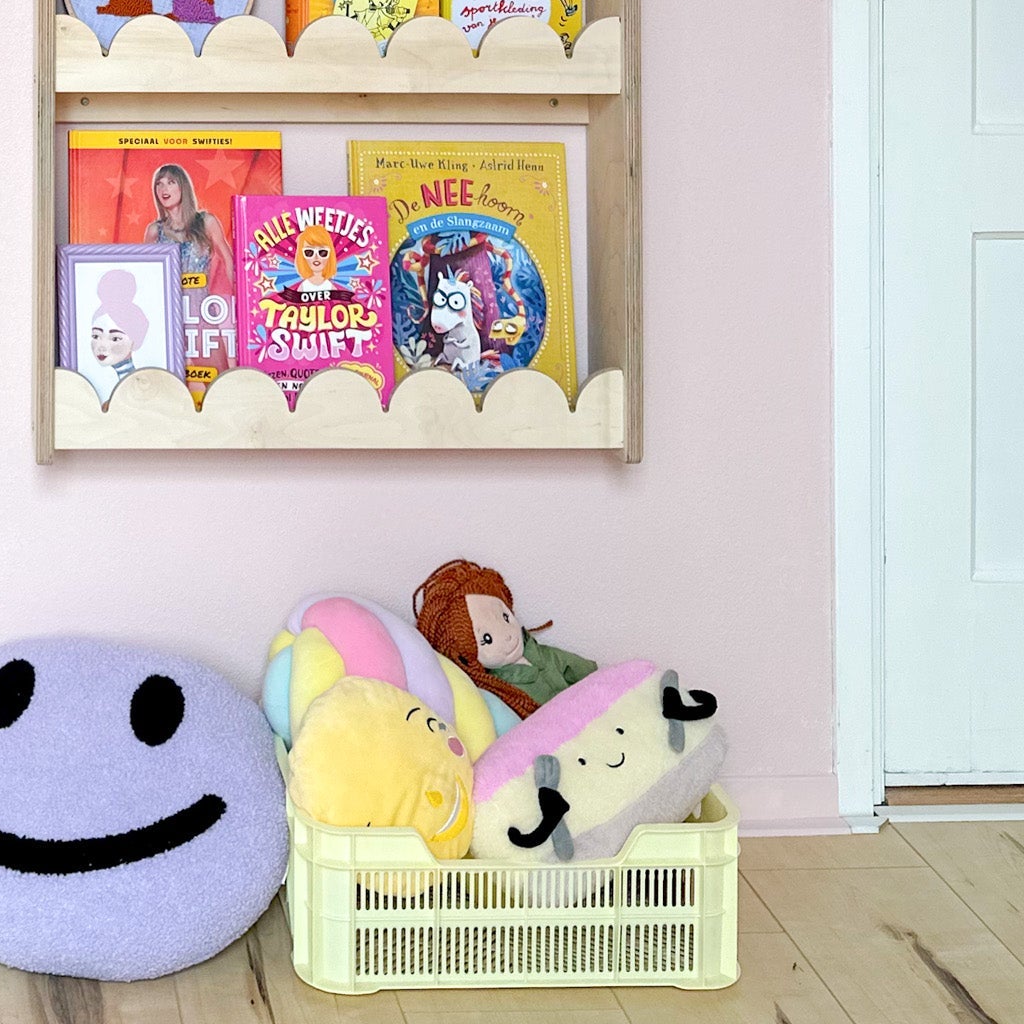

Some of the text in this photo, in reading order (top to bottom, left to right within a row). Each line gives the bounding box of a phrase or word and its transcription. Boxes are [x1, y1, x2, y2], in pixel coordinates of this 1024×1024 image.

[118, 137, 159, 145] SPECIAAL
[192, 137, 233, 145] SWIFTIES!
[438, 159, 469, 172] Kling
[480, 159, 514, 171] Astrid
[517, 159, 544, 172] Henn
[389, 198, 421, 224] De
[253, 206, 375, 252] ALLE WEETJES
[413, 215, 510, 236] en de Slangzaam
[181, 276, 200, 285] OTE
[300, 290, 331, 302] OVER
[258, 301, 378, 332] TAYLOR
[267, 328, 373, 362] SWIFT
